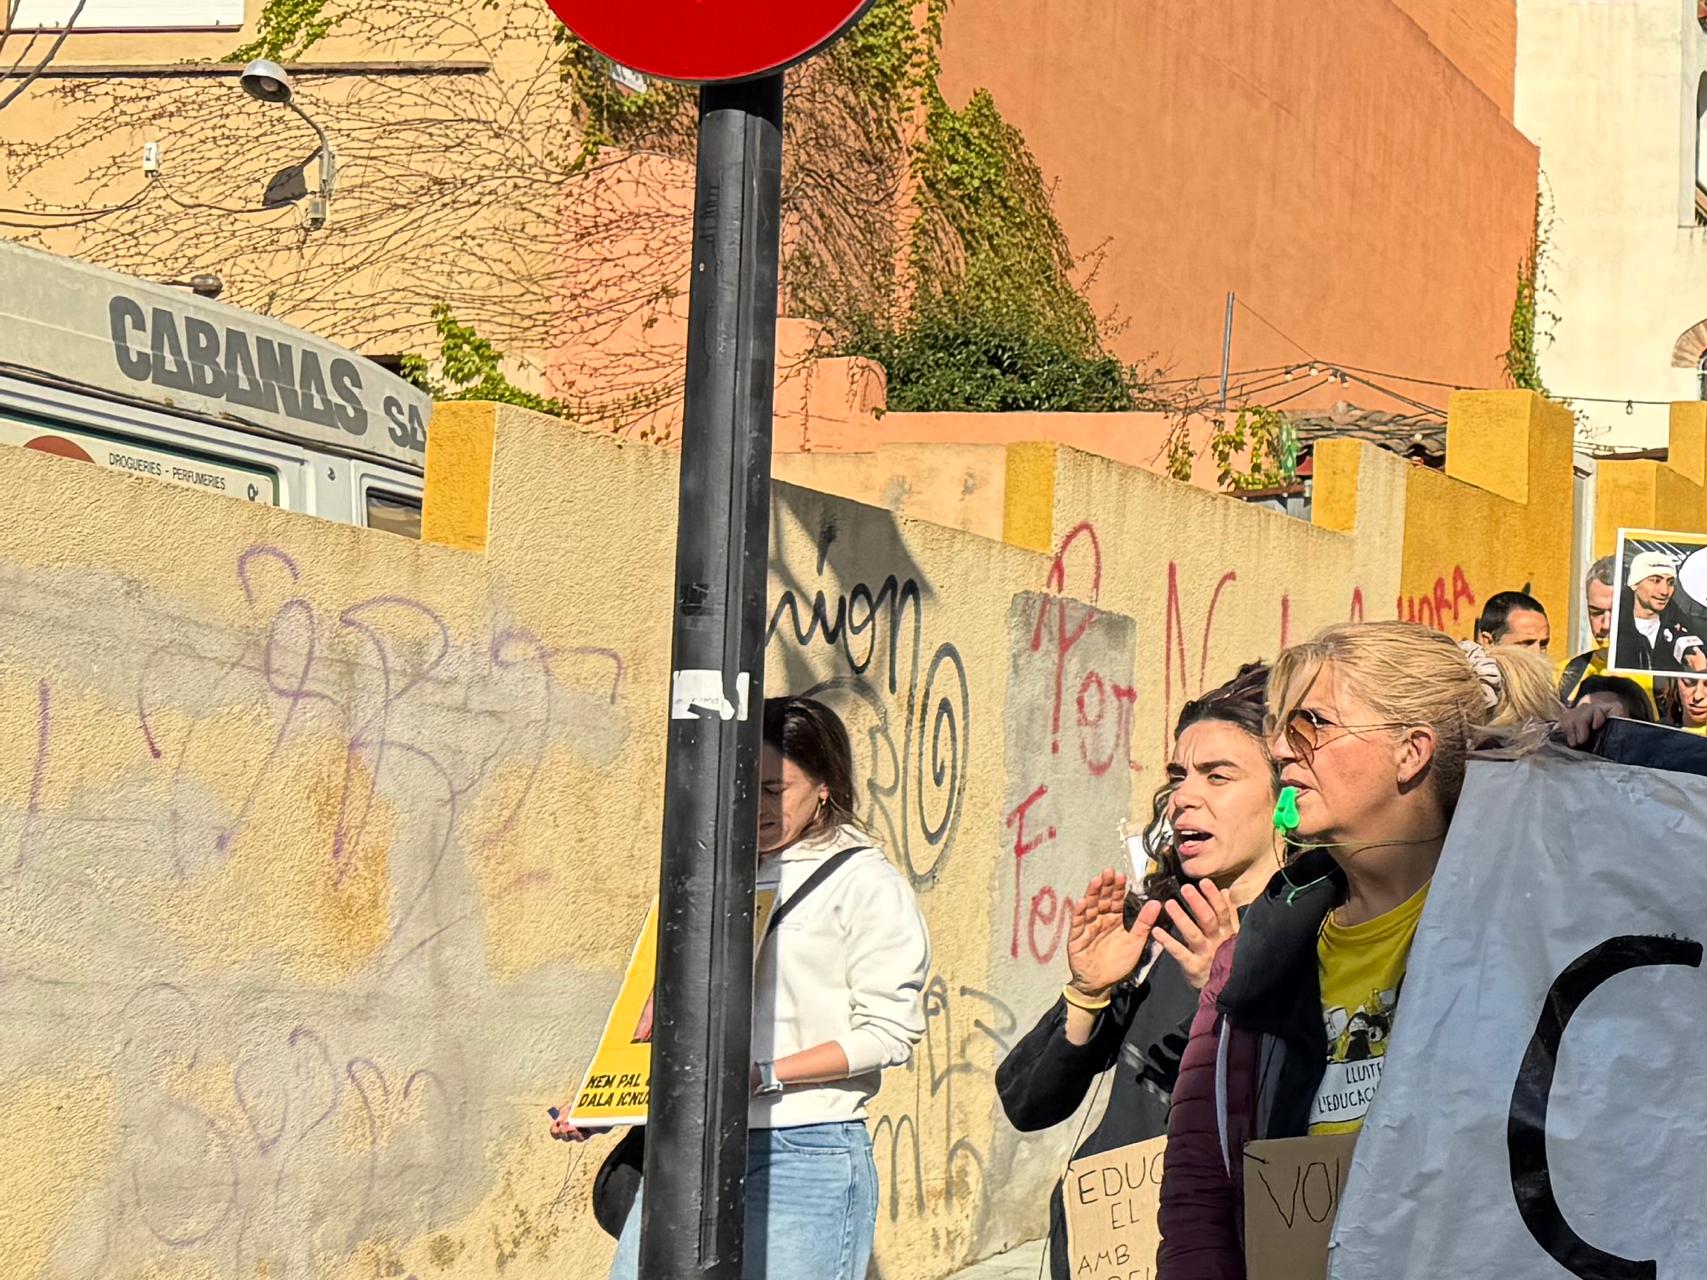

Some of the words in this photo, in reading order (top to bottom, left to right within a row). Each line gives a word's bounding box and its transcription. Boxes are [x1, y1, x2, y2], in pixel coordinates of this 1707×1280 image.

[108, 295, 369, 436] CABANAS
[109, 452, 162, 477] DROGUERIES
[172, 467, 226, 491] PERFUMERIES
[1111, 1198, 1140, 1230] EL
[1077, 1243, 1130, 1275] AMB
